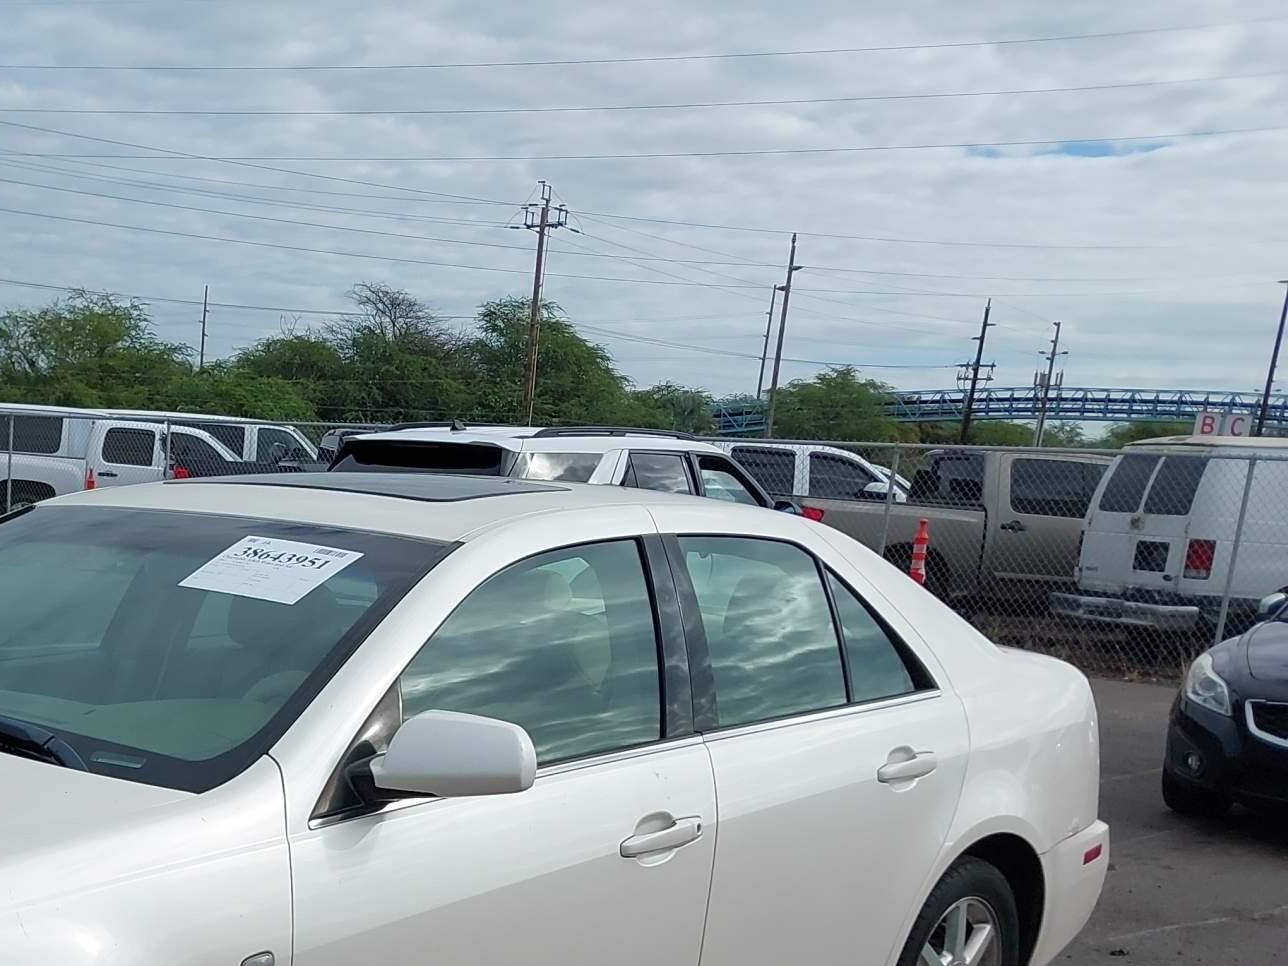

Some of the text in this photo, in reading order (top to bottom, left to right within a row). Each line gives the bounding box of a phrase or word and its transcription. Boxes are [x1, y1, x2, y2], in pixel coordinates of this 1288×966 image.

[1200, 415, 1245, 437] B C
[233, 546, 331, 570] 38643951
